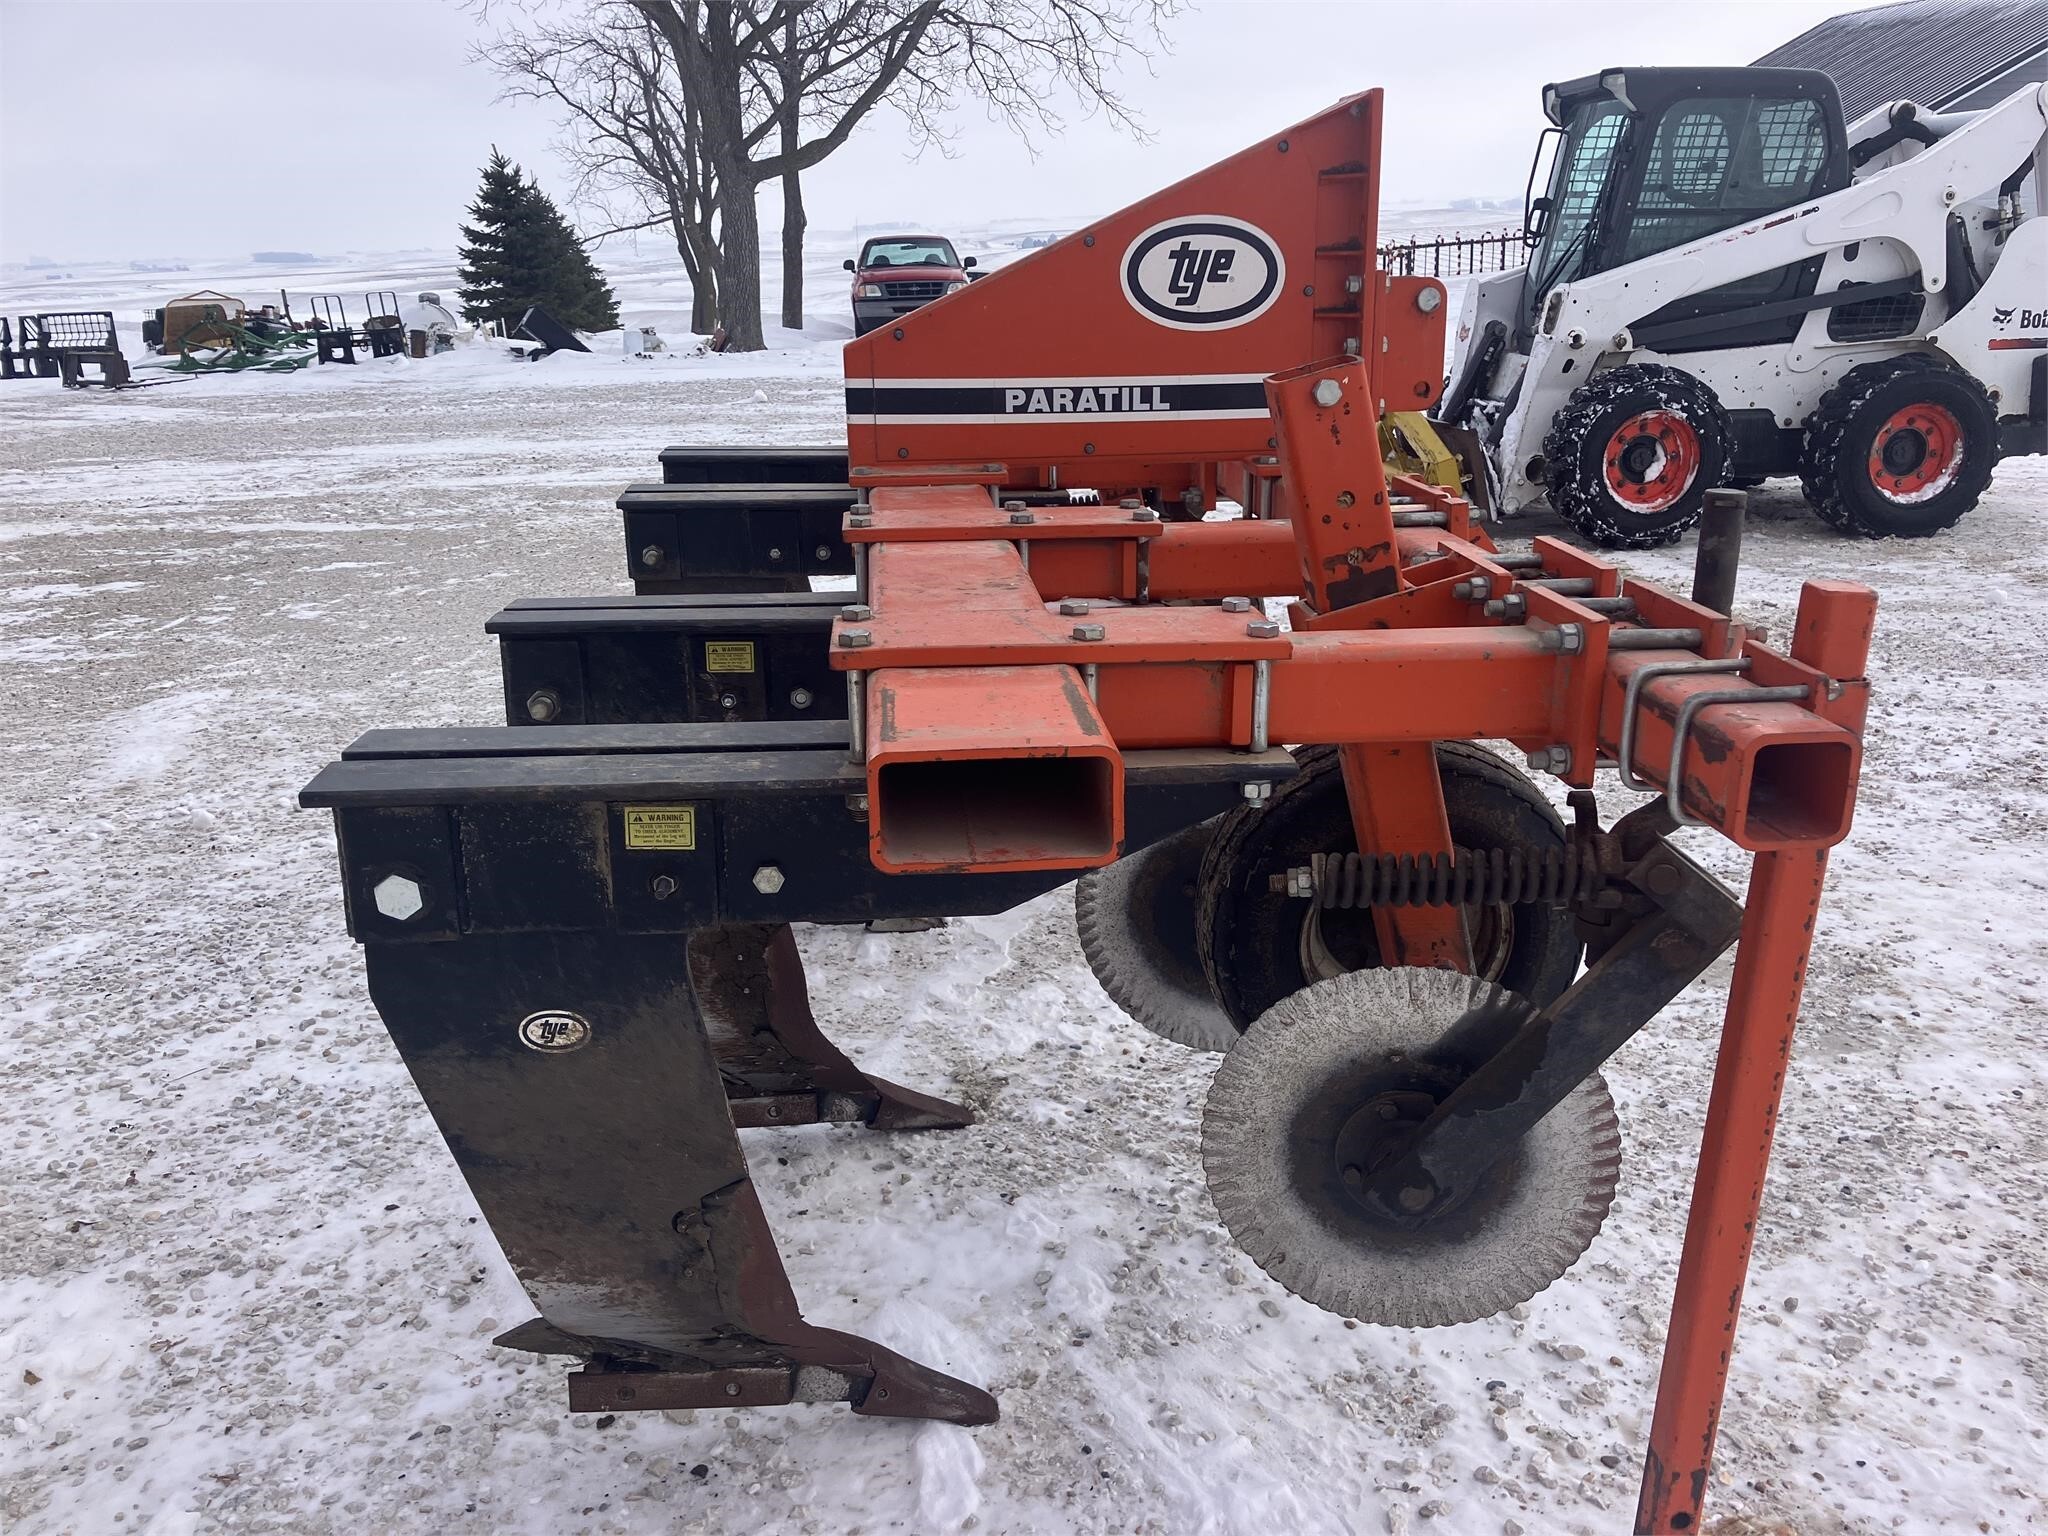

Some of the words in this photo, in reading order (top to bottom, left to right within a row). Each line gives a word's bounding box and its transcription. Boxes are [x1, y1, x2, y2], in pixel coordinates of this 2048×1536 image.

[1168, 241, 1235, 306] tye
[1005, 387, 1170, 413] PARATILL
[647, 814, 684, 822] WARNING
[540, 1020, 569, 1044] tye
